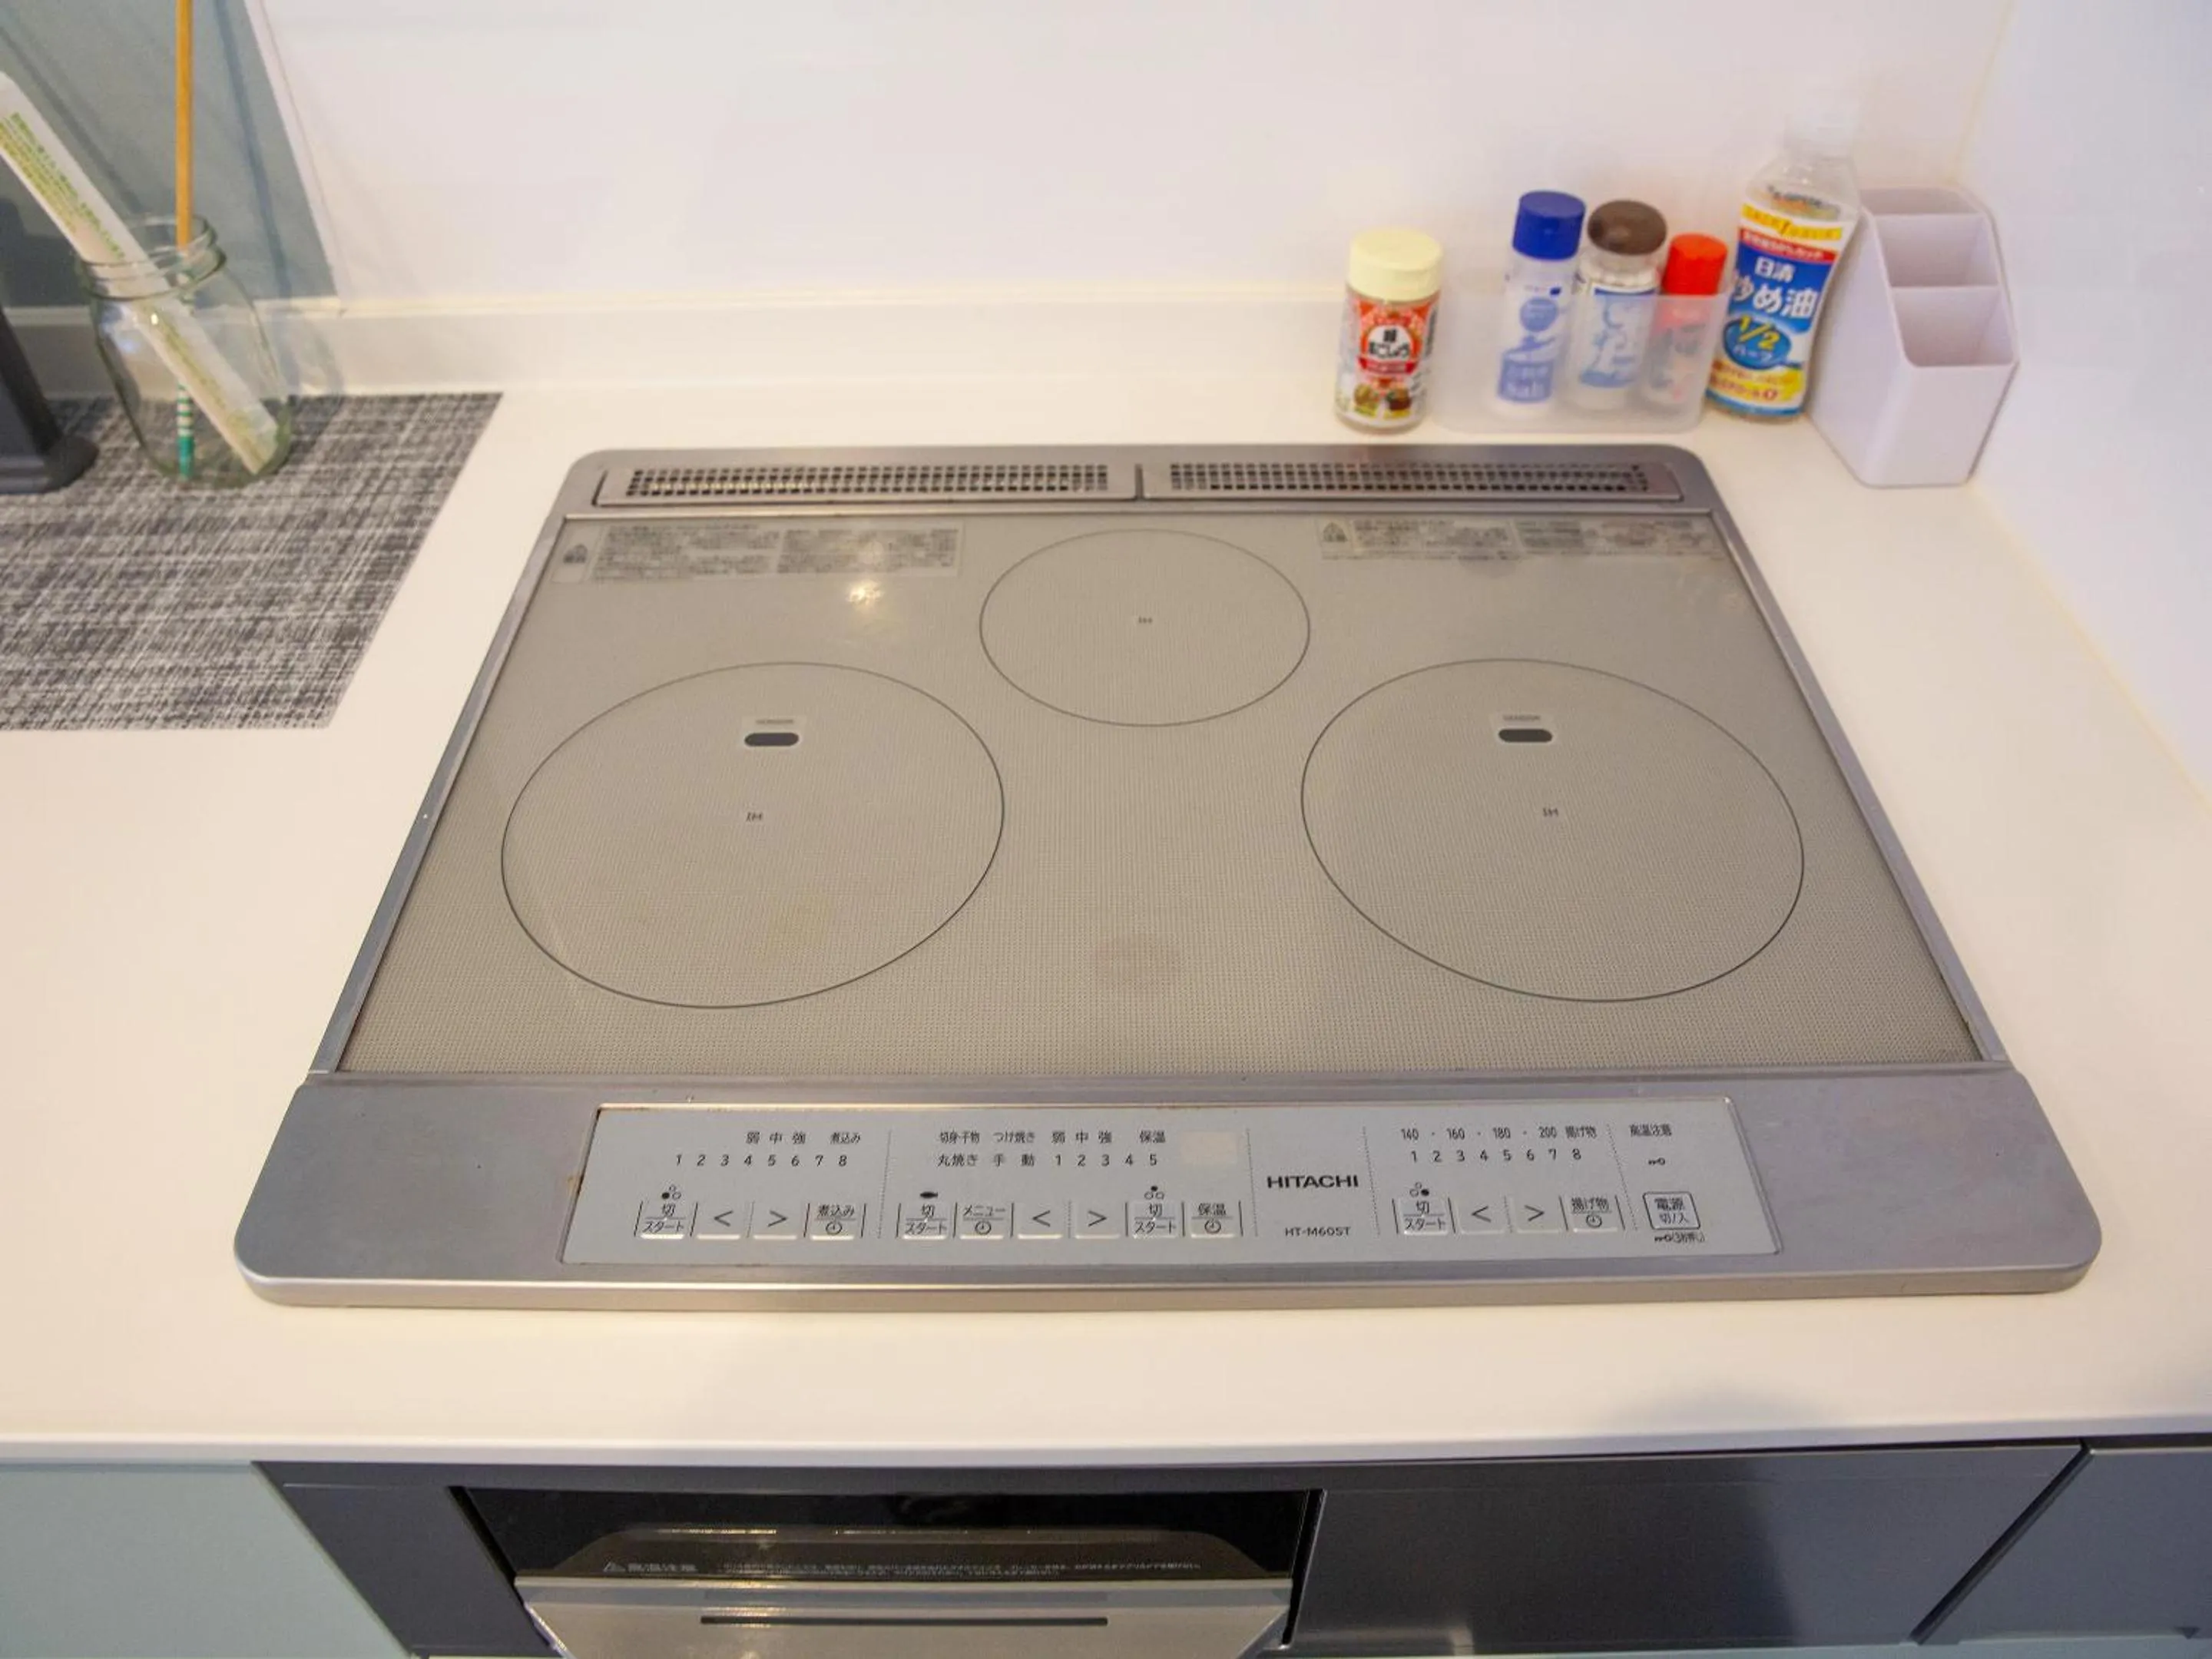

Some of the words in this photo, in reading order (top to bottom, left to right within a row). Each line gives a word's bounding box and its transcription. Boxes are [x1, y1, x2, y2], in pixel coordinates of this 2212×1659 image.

[1739, 316, 1780, 351] 1/2
[770, 1131, 783, 1144] 中
[1075, 1129, 1089, 1144] 中
[1140, 1130, 1166, 1144] 保温
[1401, 1128, 1419, 1141] 140
[1446, 1128, 1465, 1141] 160
[1492, 1127, 1512, 1140] 180
[1538, 1125, 1558, 1139] 200
[676, 1154, 682, 1167] 1
[696, 1154, 706, 1166] 2
[720, 1154, 729, 1166] 3
[743, 1154, 753, 1166] 4
[767, 1154, 777, 1167] 5
[790, 1155, 800, 1167] 6
[815, 1154, 824, 1167] 7
[838, 1154, 848, 1167] 8
[1055, 1154, 1062, 1167] 1
[1077, 1154, 1087, 1167] 2
[1101, 1154, 1111, 1167] 3
[1124, 1154, 1134, 1166] 4
[1149, 1154, 1158, 1166] 5
[1411, 1151, 1418, 1163] 1
[1432, 1150, 1442, 1162] 2
[1456, 1150, 1465, 1162] 3
[1479, 1149, 1488, 1161] 4
[1502, 1149, 1512, 1161] 5
[1525, 1148, 1535, 1161] 6
[1548, 1148, 1558, 1161] 7
[1572, 1147, 1582, 1161] 8
[1267, 1174, 1359, 1188] HITACHI
[661, 1203, 677, 1217] 切
[921, 1204, 936, 1217] 切
[962, 1204, 1006, 1217] メニュー
[1147, 1203, 1164, 1216] 切
[1197, 1203, 1227, 1216] 保温
[1415, 1200, 1431, 1214] 切
[642, 1220, 684, 1233] スタート
[906, 1220, 949, 1234] スタート
[1134, 1220, 1177, 1233] スタート
[1403, 1217, 1446, 1230] スタート
